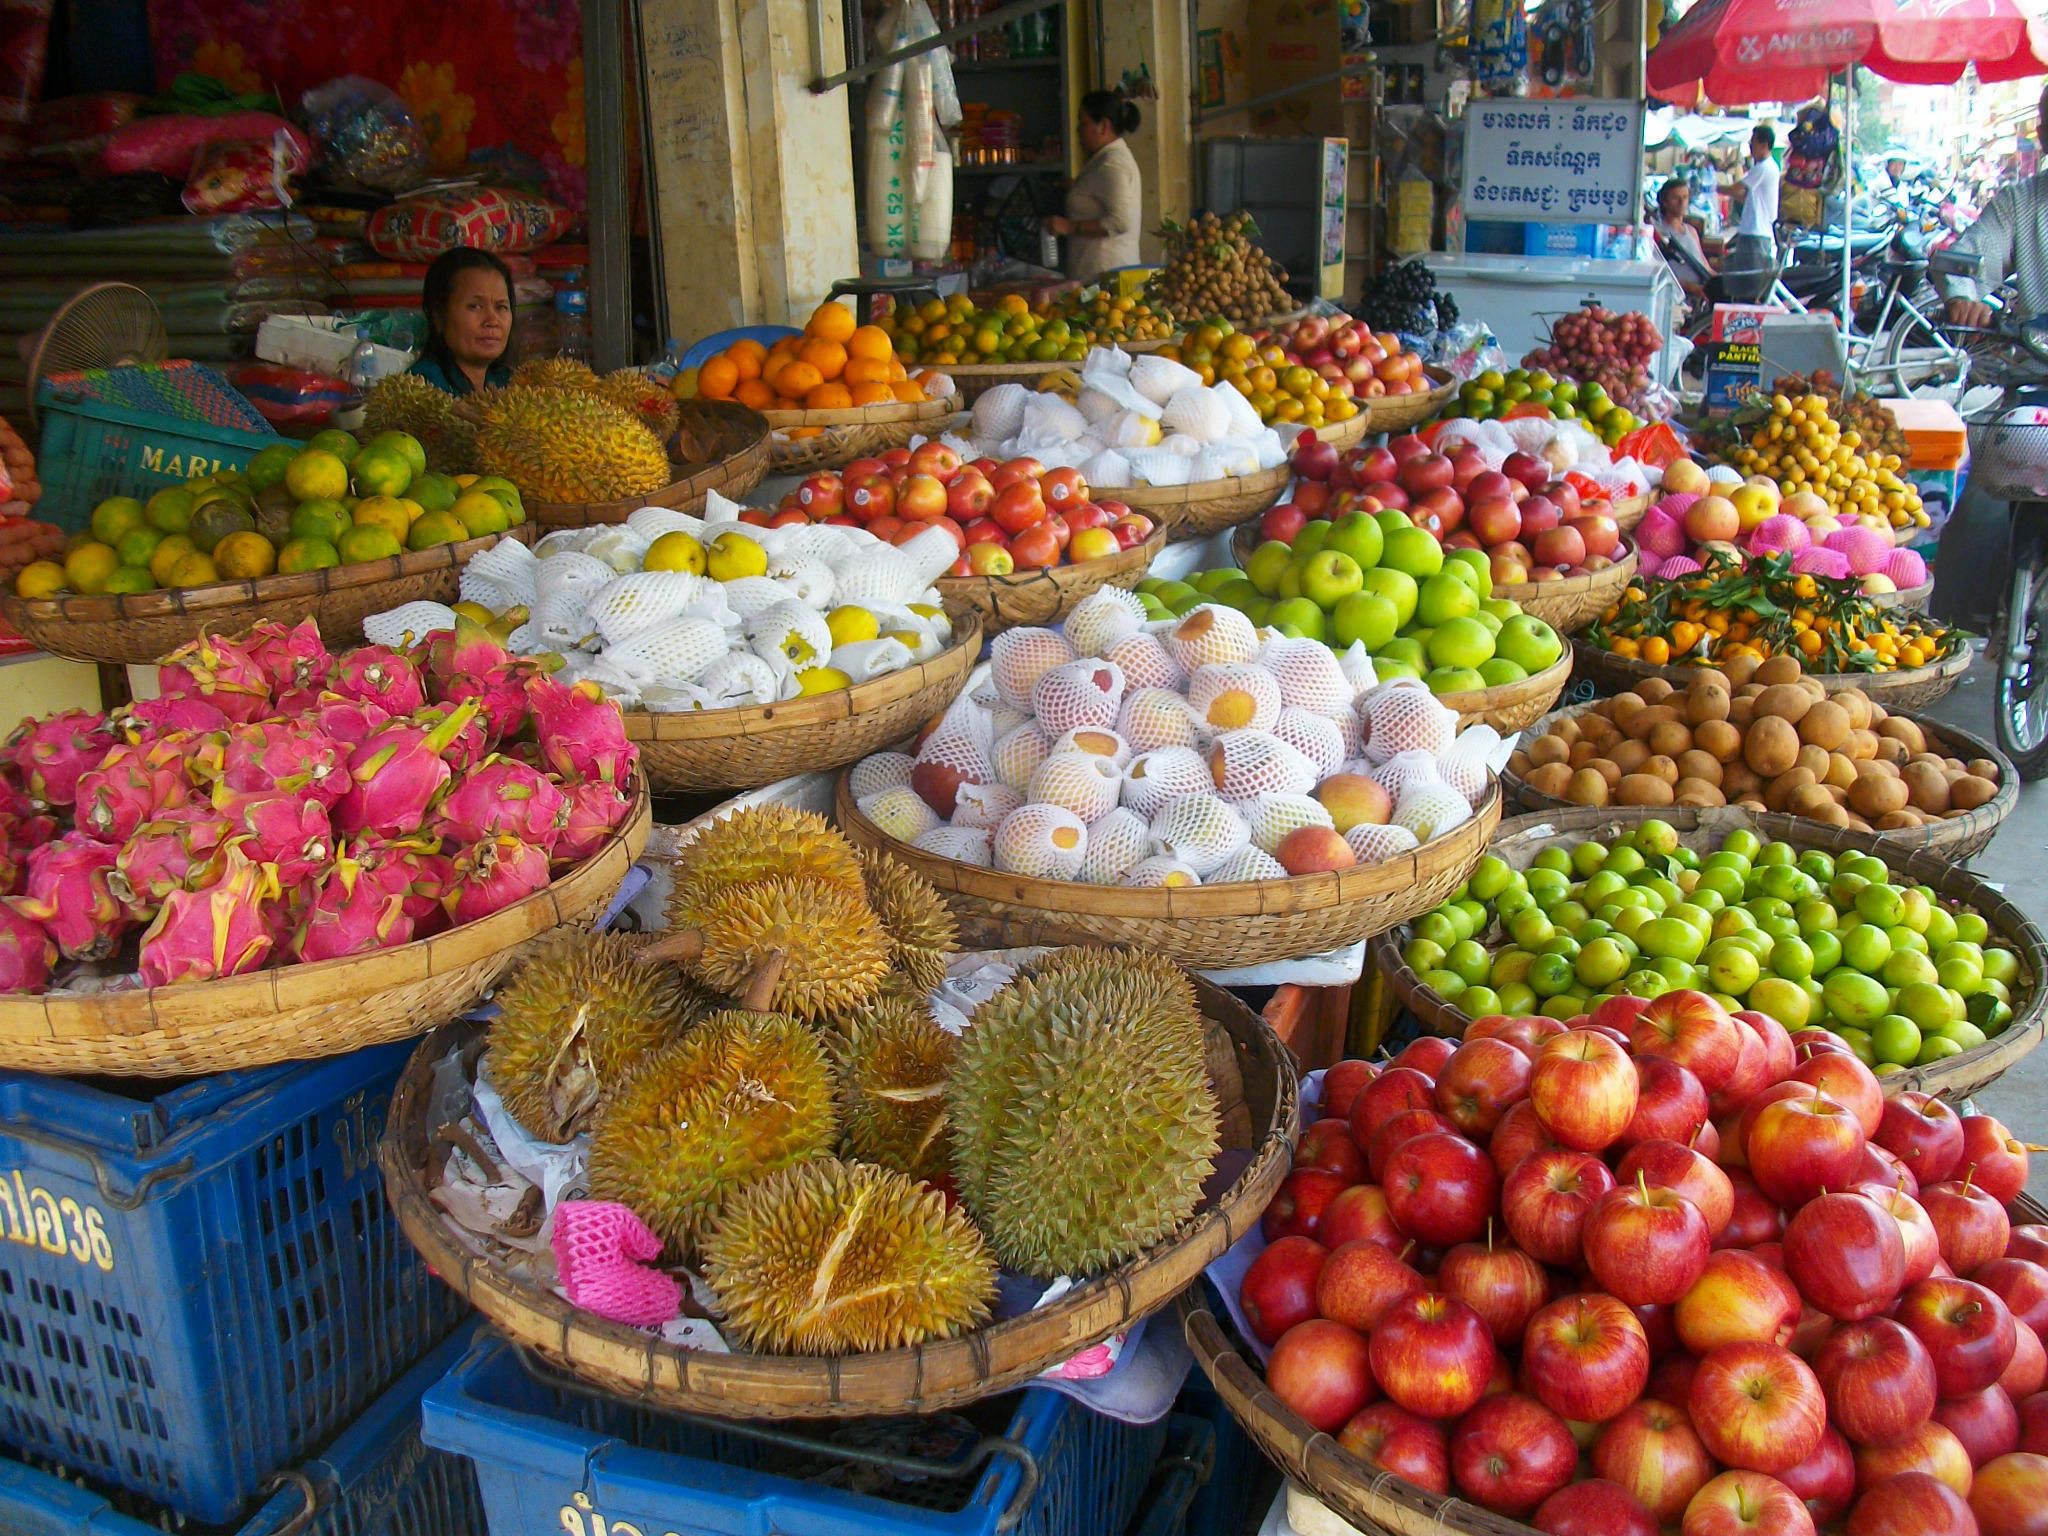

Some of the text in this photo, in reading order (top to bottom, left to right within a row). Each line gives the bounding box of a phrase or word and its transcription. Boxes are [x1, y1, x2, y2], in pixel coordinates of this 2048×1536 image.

[1768, 27, 1857, 52] ANCHOR
[887, 193, 905, 249] 2K 52
